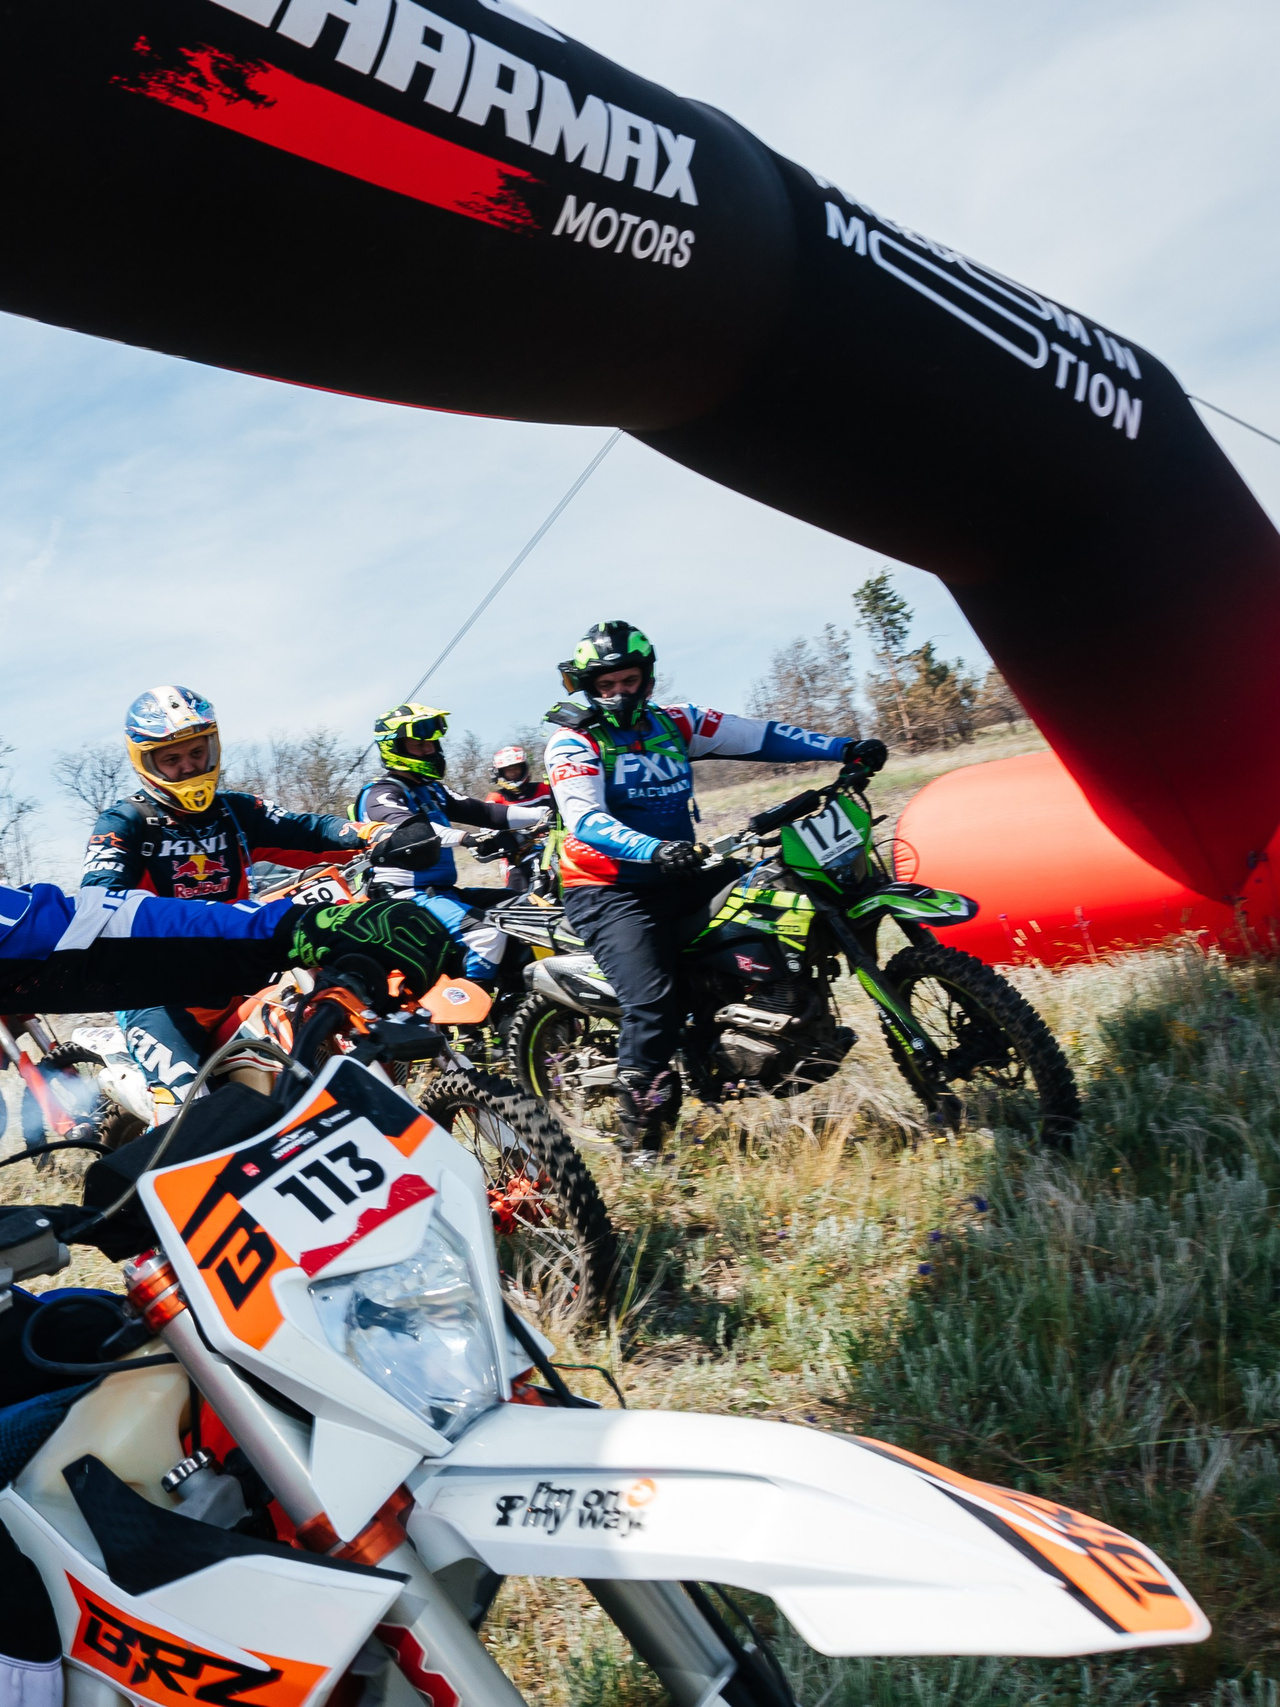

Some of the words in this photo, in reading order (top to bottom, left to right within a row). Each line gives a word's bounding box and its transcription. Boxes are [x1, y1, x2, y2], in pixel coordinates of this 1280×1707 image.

[552, 195, 696, 269] MOTORS
[800, 804, 853, 851] 12
[174, 881, 203, 898] Red
[274, 1140, 387, 1223] 113
